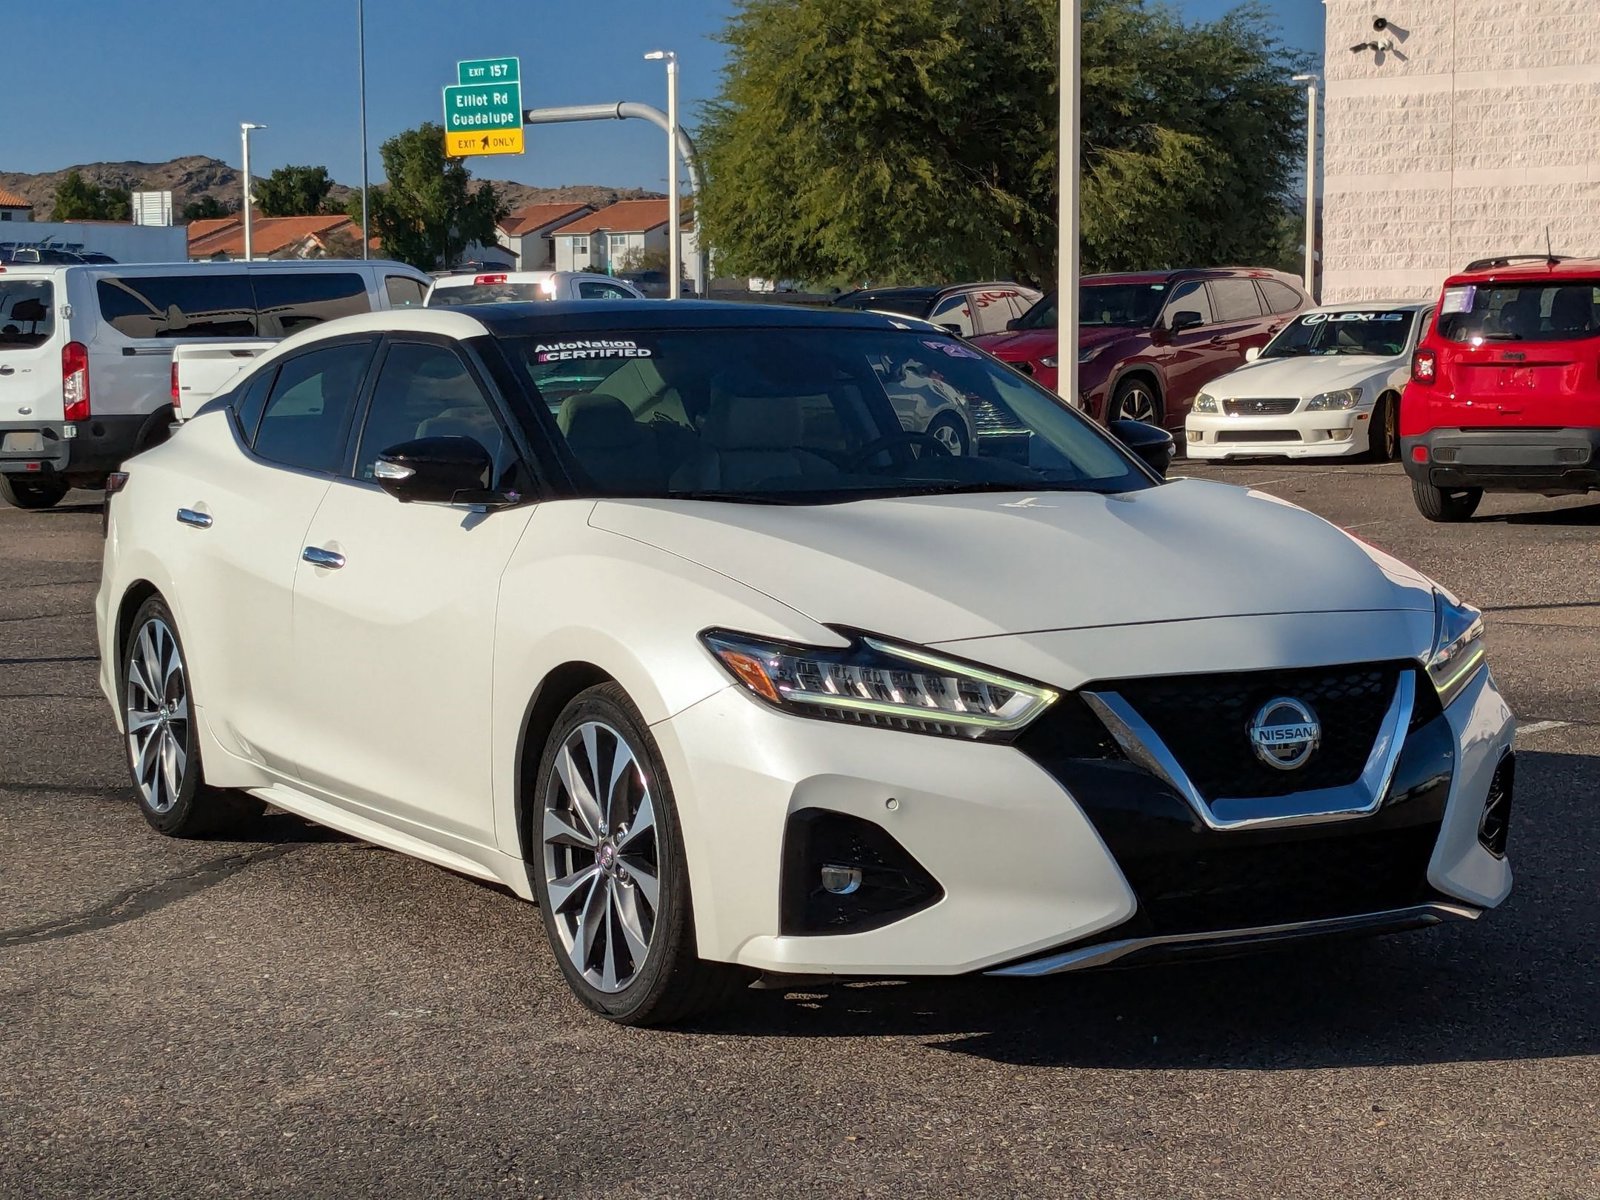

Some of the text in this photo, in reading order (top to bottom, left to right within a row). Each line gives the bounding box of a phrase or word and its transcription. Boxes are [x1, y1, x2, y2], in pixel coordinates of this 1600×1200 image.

[468, 64, 508, 77] EXIT 157
[456, 92, 508, 107] Elliot Rd
[452, 112, 514, 125] Guadalupe
[458, 138, 515, 148] EXIT ONLY
[1328, 313, 1403, 322] LEXUS
[534, 340, 637, 352] AutoNation
[546, 348, 652, 361] CERTIFIED
[1258, 727, 1312, 740] NISSAN
